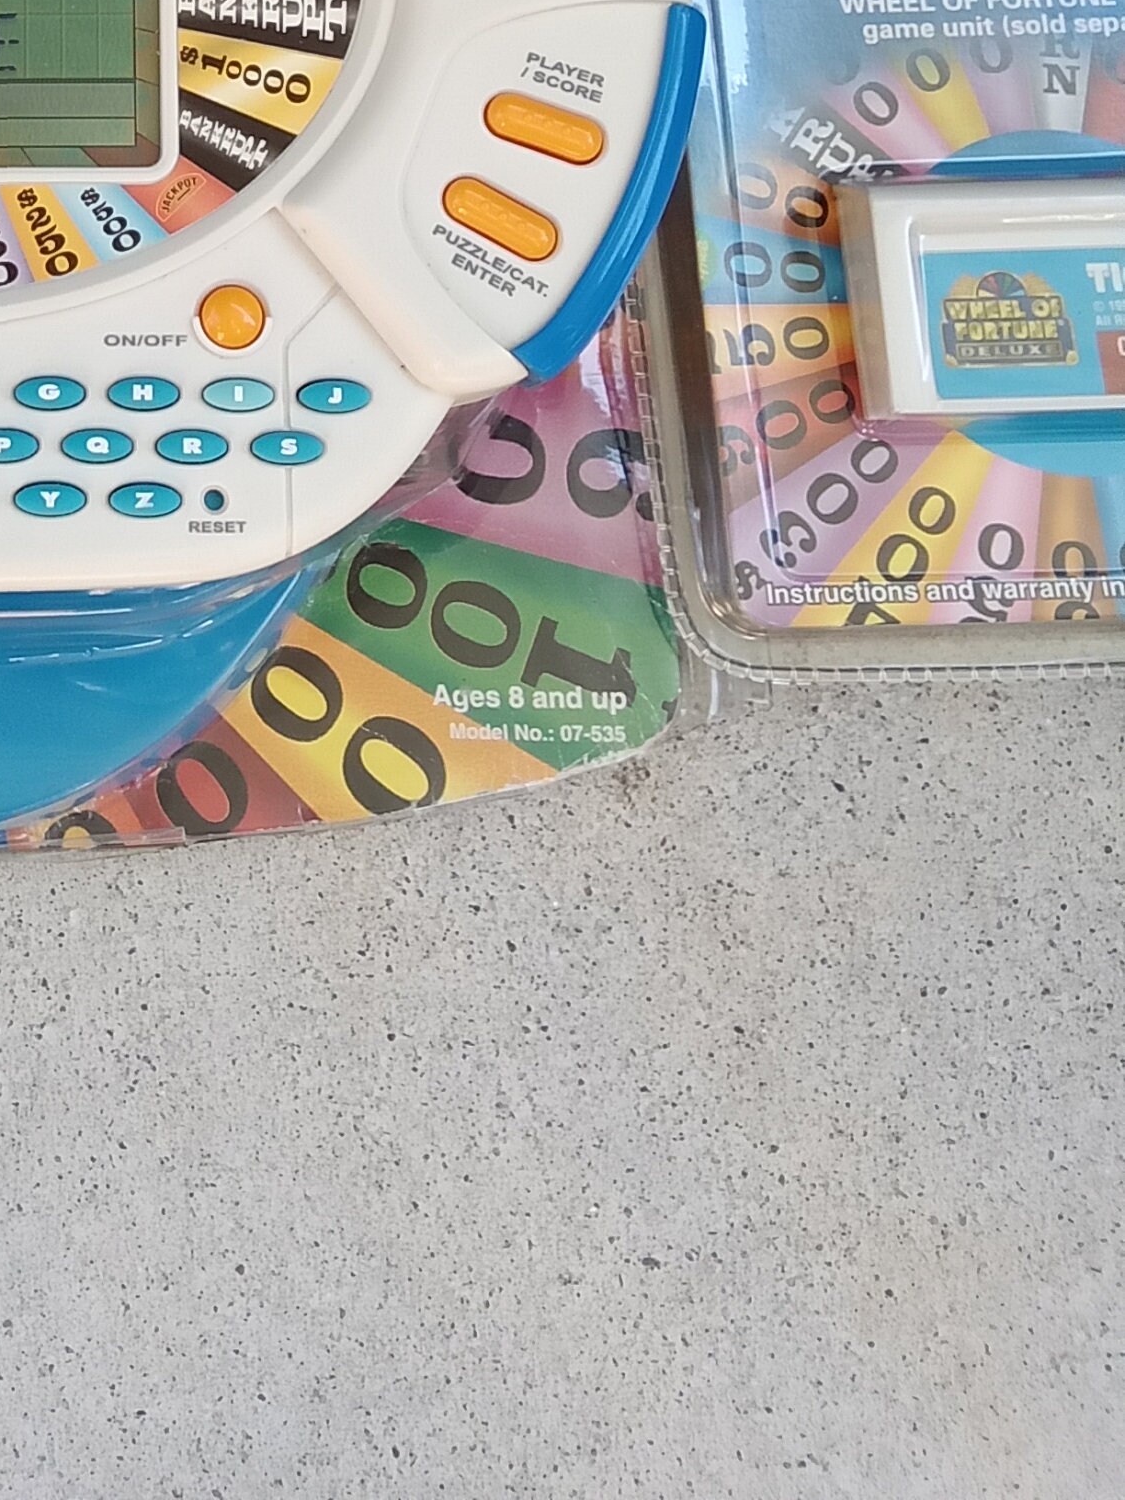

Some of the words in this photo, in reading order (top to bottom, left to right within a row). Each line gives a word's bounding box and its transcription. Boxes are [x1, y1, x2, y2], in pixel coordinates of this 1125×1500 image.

[863, 20, 935, 45] game
[943, 17, 995, 38] unit
[1002, 14, 1066, 39] (sold
[526, 51, 605, 88] PLAYER
[532, 70, 604, 104] SCORE
[179, 109, 269, 171] BANKRUPT
[161, 176, 199, 212] JACKPOT
[16, 187, 80, 278] $250
[431, 223, 550, 298] PUZZLE/CAT.
[450, 252, 517, 298] ENTER
[946, 300, 1027, 320] WHEEL
[103, 333, 188, 348] ON/OFF
[954, 319, 1058, 341] FORTUNE
[961, 344, 1057, 357] DELUXE
[38, 384, 61, 401] G
[132, 384, 153, 401] H
[234, 385, 243, 402] I
[328, 387, 343, 405] J
[85, 437, 110, 454] Q
[182, 438, 203, 455] R
[280, 438, 299, 456] S
[39, 491, 61, 508] Y
[134, 492, 155, 509] Z
[188, 520, 247, 534] RESET
[766, 579, 919, 605] Instructions
[926, 577, 975, 601] and
[981, 574, 1093, 603] warranty
[432, 684, 501, 712] Ages
[509, 685, 525, 707] 8
[532, 685, 583, 710] and
[591, 690, 628, 715] up
[449, 722, 508, 741] Model
[513, 724, 555, 742] No.:
[560, 725, 627, 742] 07-535
